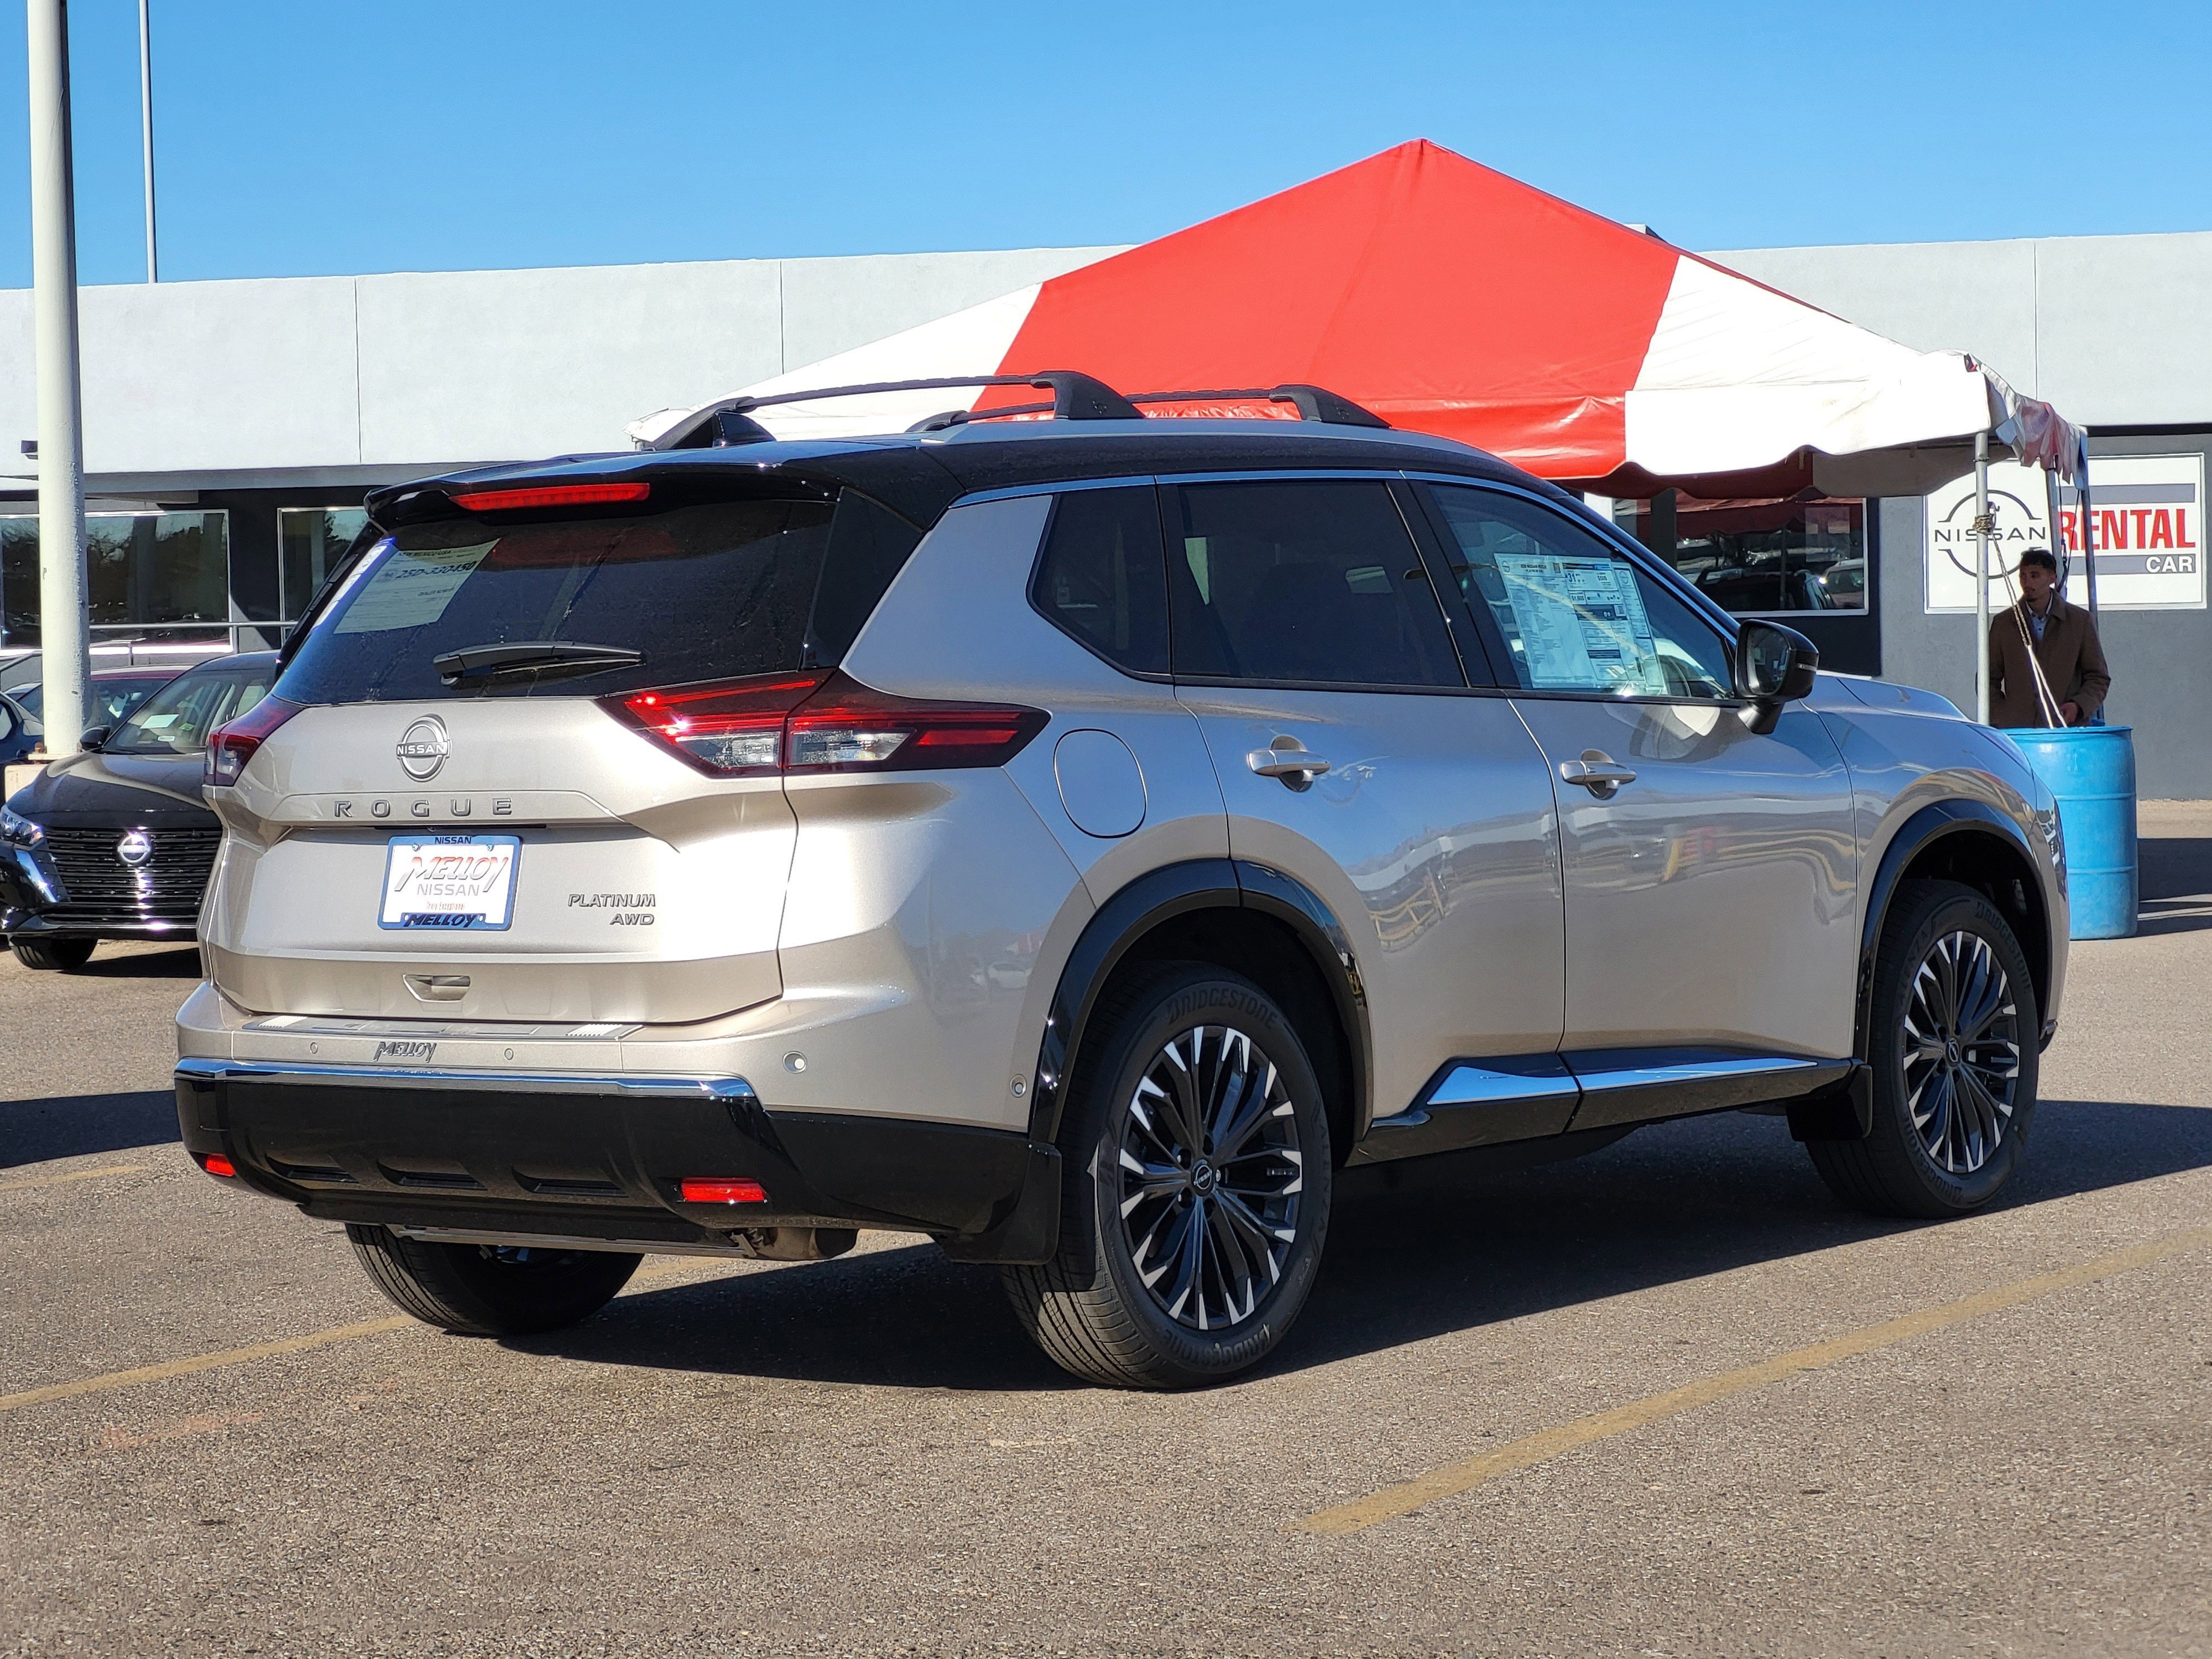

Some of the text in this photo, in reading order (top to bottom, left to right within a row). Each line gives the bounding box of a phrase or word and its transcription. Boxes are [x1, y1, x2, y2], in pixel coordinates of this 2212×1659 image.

[1935, 526, 2046, 543] NISSAN
[2058, 508, 2196, 551] RENTAL
[2146, 555, 2193, 573] CAR
[397, 744, 447, 755] NISSAN
[334, 797, 512, 818] ROGUE
[435, 836, 472, 844] NISSAN
[394, 857, 509, 893] MELLOY
[418, 884, 479, 896] NISSAN
[568, 894, 656, 907] PLATINUM
[404, 914, 478, 928] MELLOY
[609, 913, 655, 926] AWD
[1166, 987, 1277, 1029] BRIDGESTONE
[373, 1041, 437, 1063] MELLOY
